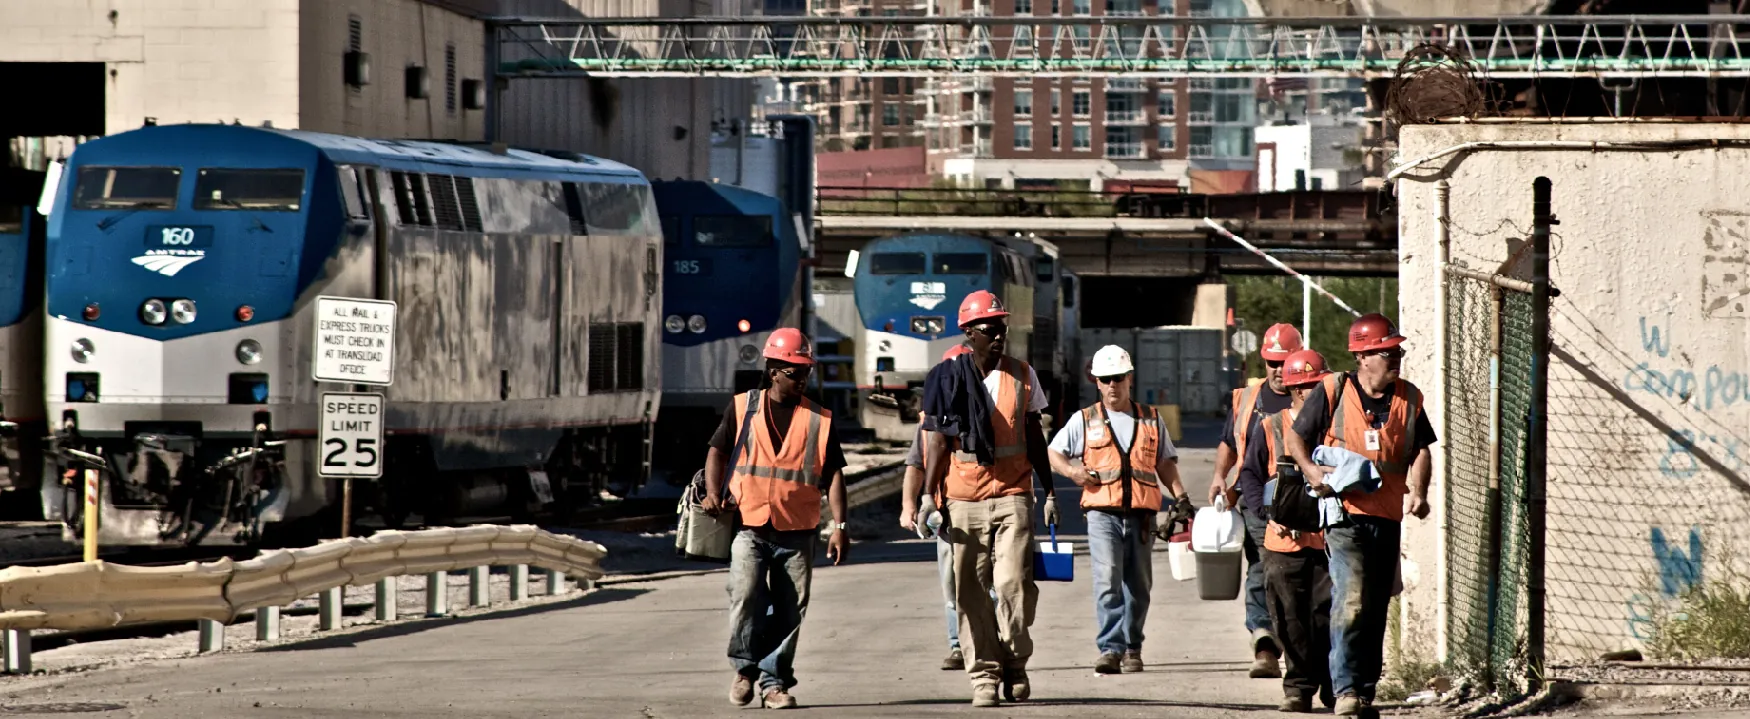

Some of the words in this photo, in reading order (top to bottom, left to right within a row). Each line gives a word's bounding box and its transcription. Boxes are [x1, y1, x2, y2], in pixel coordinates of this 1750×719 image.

[162, 227, 194, 245] 160
[673, 260, 699, 274] 185
[334, 307, 348, 317] ALL
[320, 319, 357, 332] EXPRESS
[360, 322, 390, 333] TRUCKS
[324, 334, 344, 345] MUST
[348, 336, 374, 347] CHECK
[376, 338, 385, 347] IN
[325, 349, 335, 358] AT
[337, 350, 383, 362] TRANSLOAD
[326, 402, 378, 415] SPEED
[331, 420, 372, 432] LIMIT
[324, 438, 377, 467] 25
